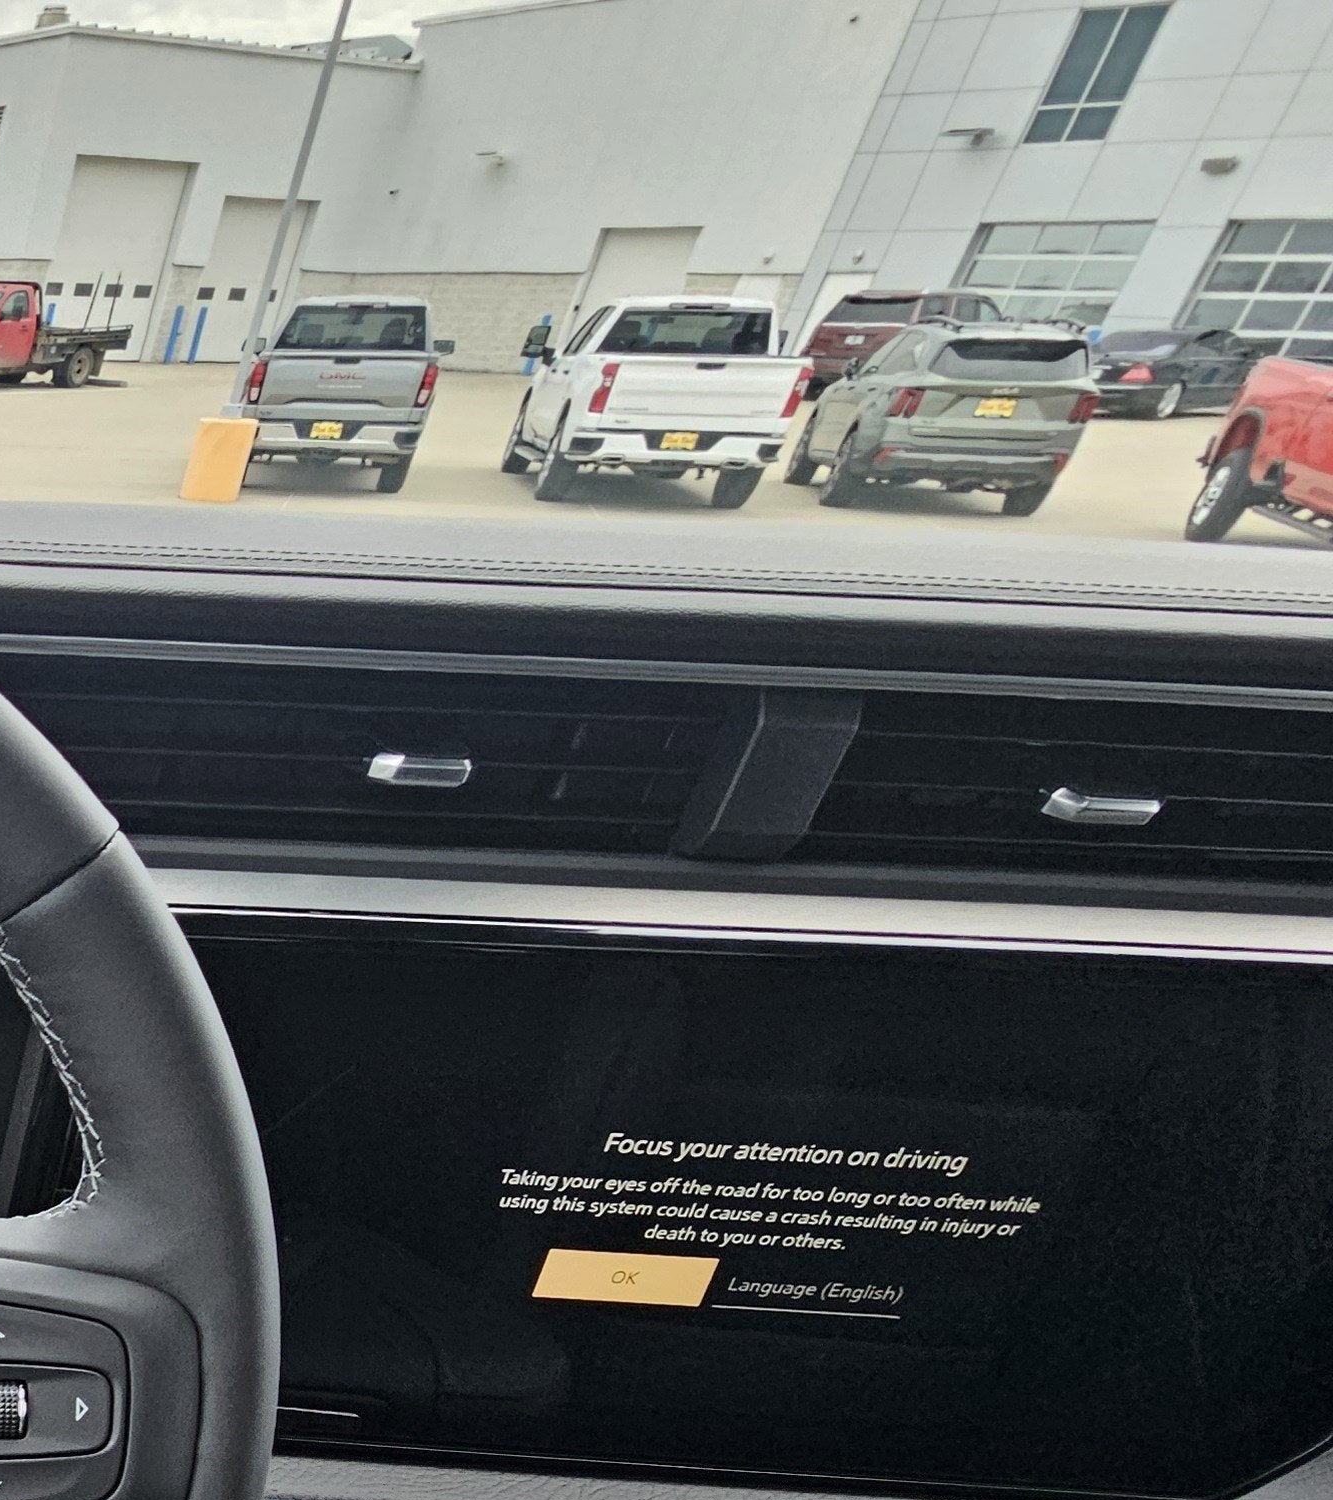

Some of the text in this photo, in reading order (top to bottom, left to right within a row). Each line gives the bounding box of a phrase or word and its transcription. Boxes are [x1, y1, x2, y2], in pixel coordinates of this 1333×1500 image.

[603, 1132, 969, 1178] Focus your attention on driving
[500, 1168, 1041, 1214] Taking your eyes off the road for too long or too often while
[498, 1194, 1022, 1239] using this system could cause a crash resulting in injury or
[644, 1224, 846, 1250] death to you or others.
[610, 1270, 641, 1285] OK
[728, 1276, 905, 1306] Language (English)
